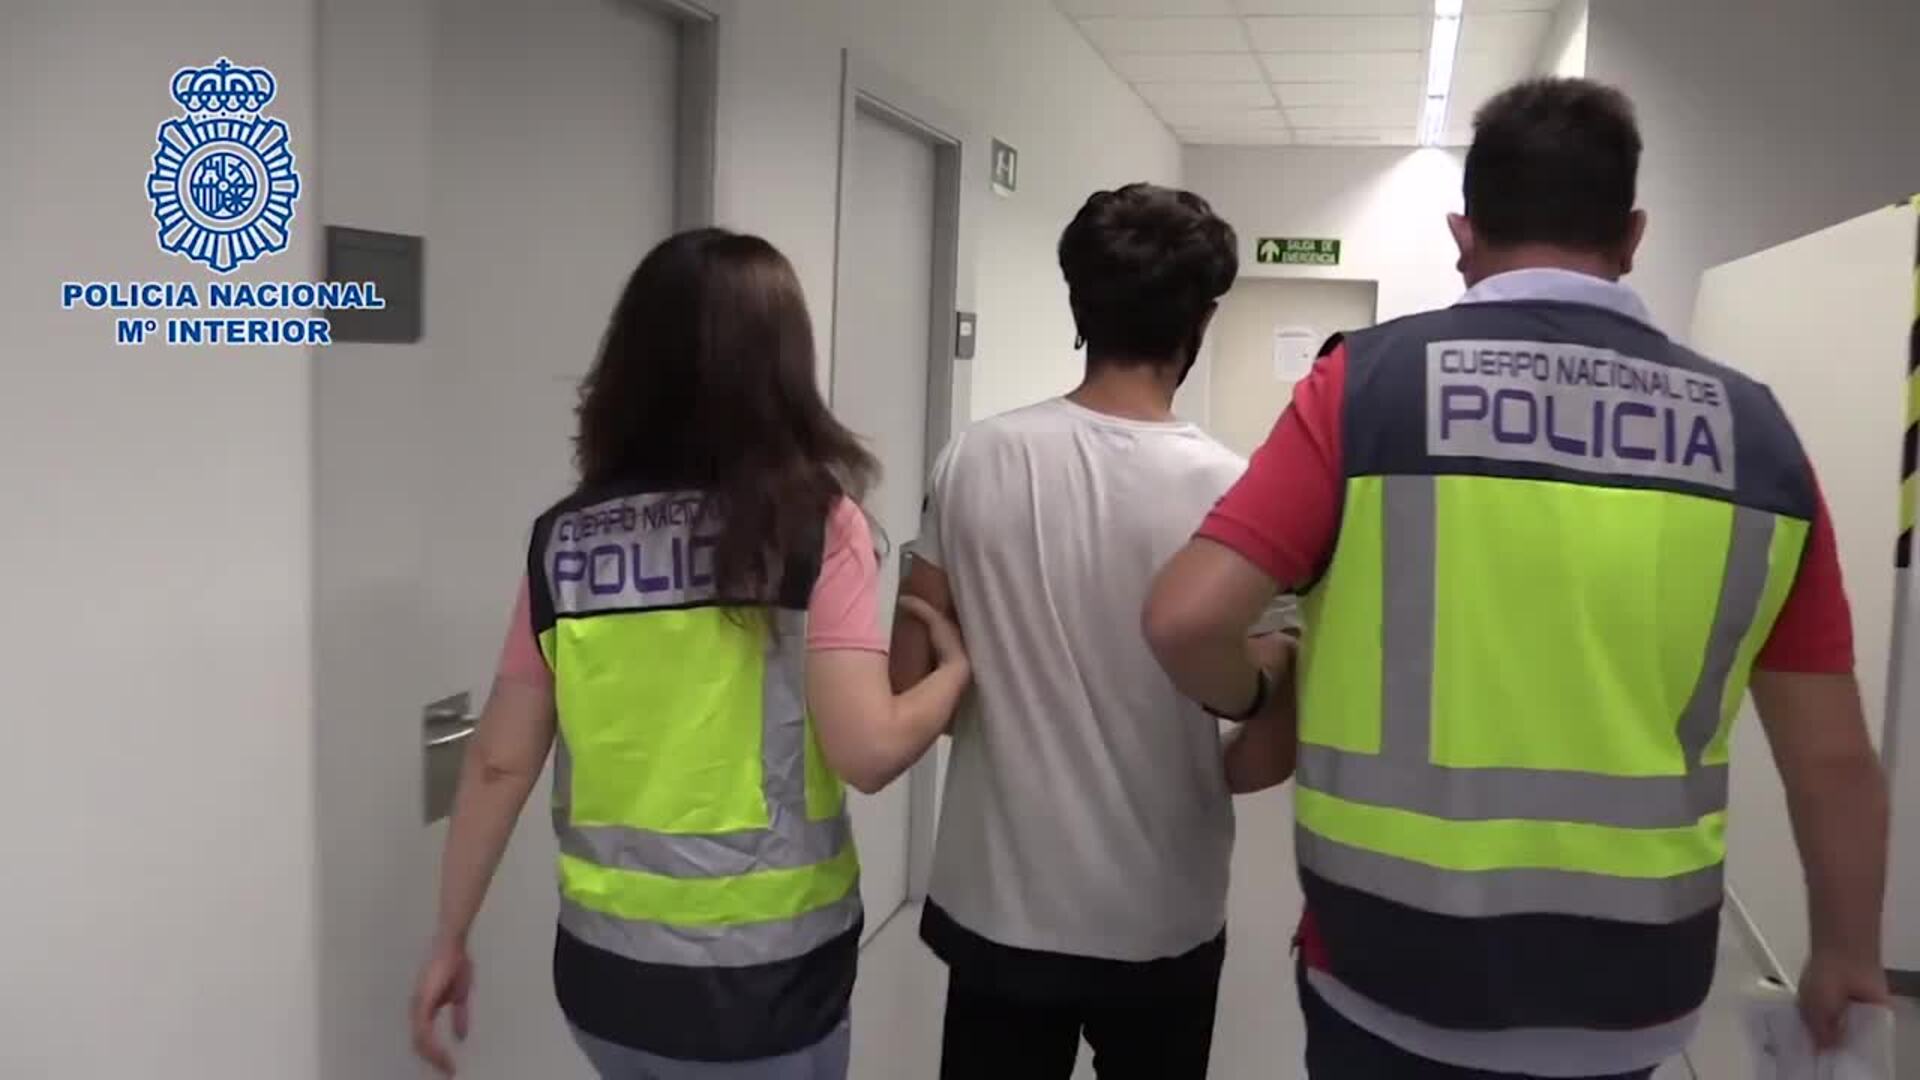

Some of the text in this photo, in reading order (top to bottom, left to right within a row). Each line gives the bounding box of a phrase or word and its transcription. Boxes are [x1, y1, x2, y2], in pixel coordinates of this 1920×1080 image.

[1440, 349, 1719, 407] CUERPO NACIONAL DE
[1440, 384, 1722, 474] POLICIA
[558, 505, 637, 543] CUERPO
[552, 536, 722, 598] POLIC
